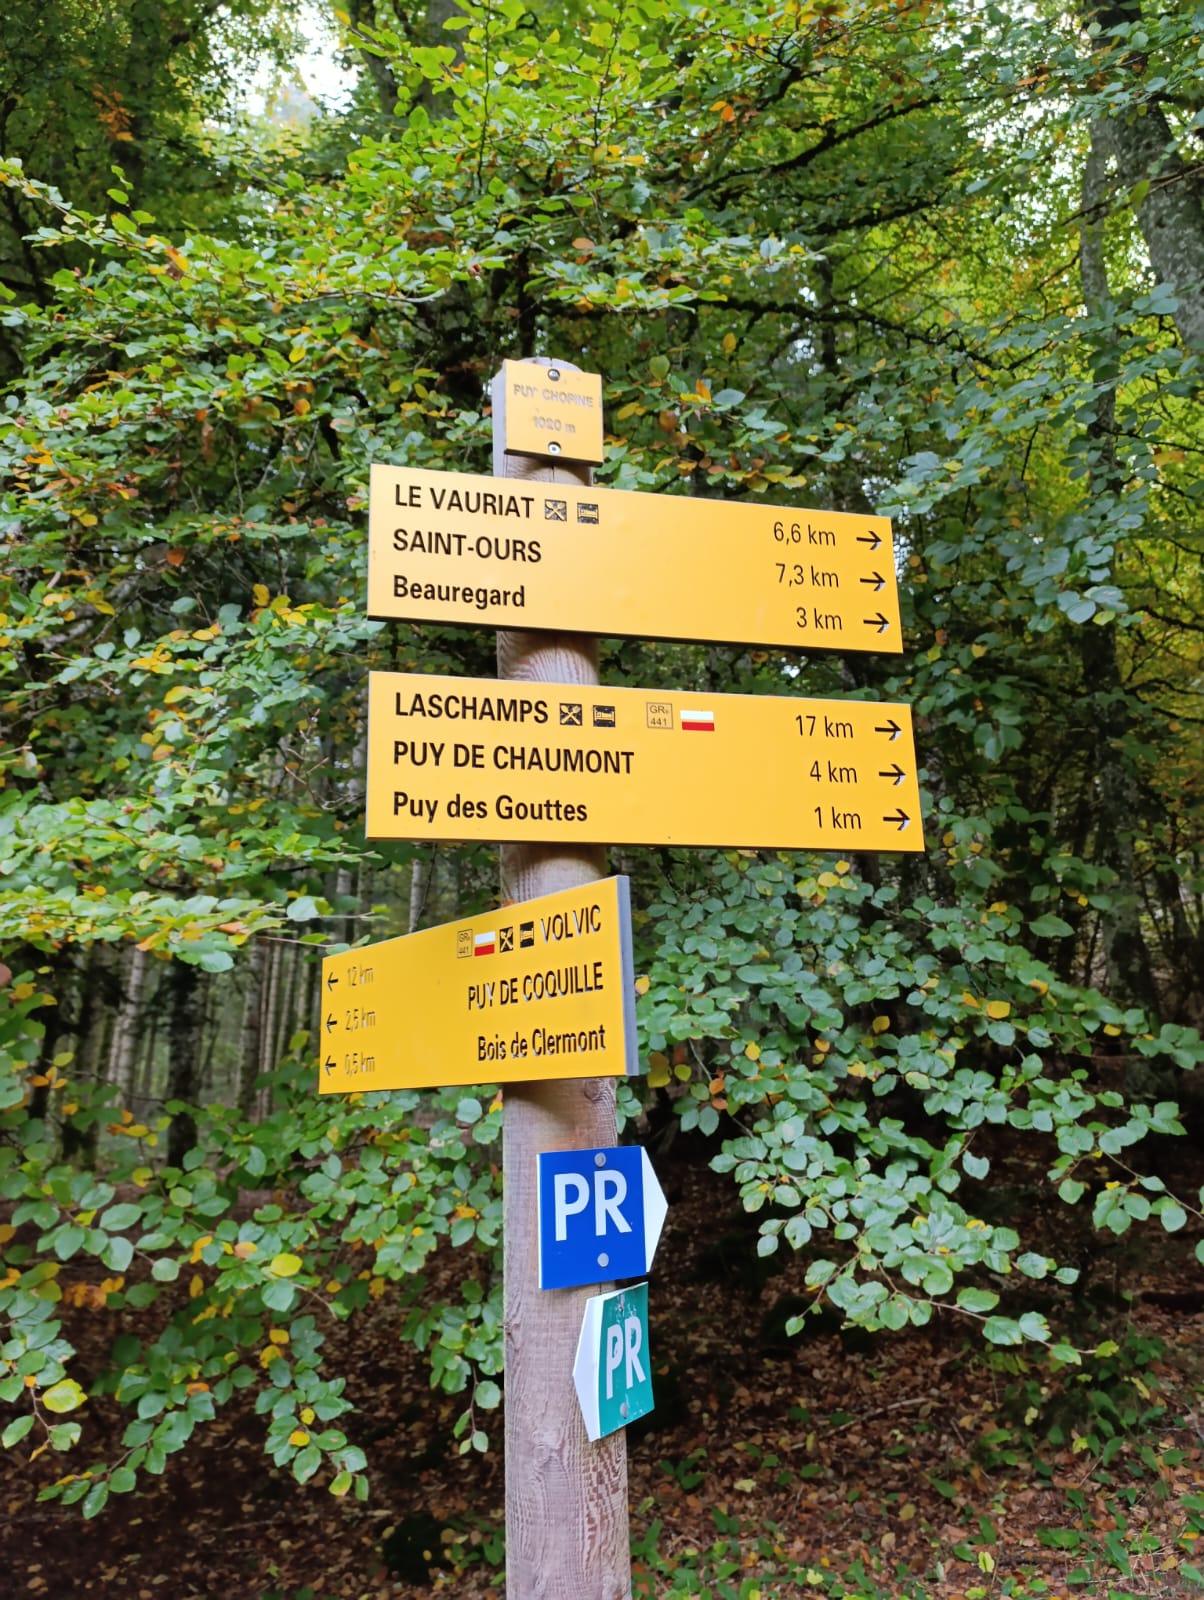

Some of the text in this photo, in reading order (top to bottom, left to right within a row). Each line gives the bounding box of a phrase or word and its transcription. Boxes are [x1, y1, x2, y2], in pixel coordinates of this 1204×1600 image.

[513, 384, 537, 398] PUY
[565, 424, 576, 432] m
[395, 484, 534, 518] LE VAURIAT
[393, 528, 542, 563] SAINT-OURS
[773, 522, 835, 546] 6,6 km
[775, 563, 839, 588] 7,3 km
[393, 575, 525, 610] Beauregard
[796, 607, 842, 630] 3 km
[395, 692, 548, 724] LASCHAMPS
[650, 717, 667, 726] 441
[796, 715, 853, 738] 17 km
[393, 741, 634, 774] PUY DE CHAUMONT
[809, 760, 857, 783] 4 km
[393, 791, 588, 823] Puy des Gouttes
[814, 806, 861, 829] 1 km
[541, 904, 601, 943] VOLVIC
[346, 965, 374, 987] 12 km
[467, 961, 604, 1010] PUY DE COQUILLE
[345, 1008, 376, 1032] 2,5 km
[478, 1024, 606, 1062] Bois de Clermont
[344, 1052, 376, 1076] 0,5 km
[554, 1169, 633, 1242] PR
[606, 1316, 647, 1400] PR
